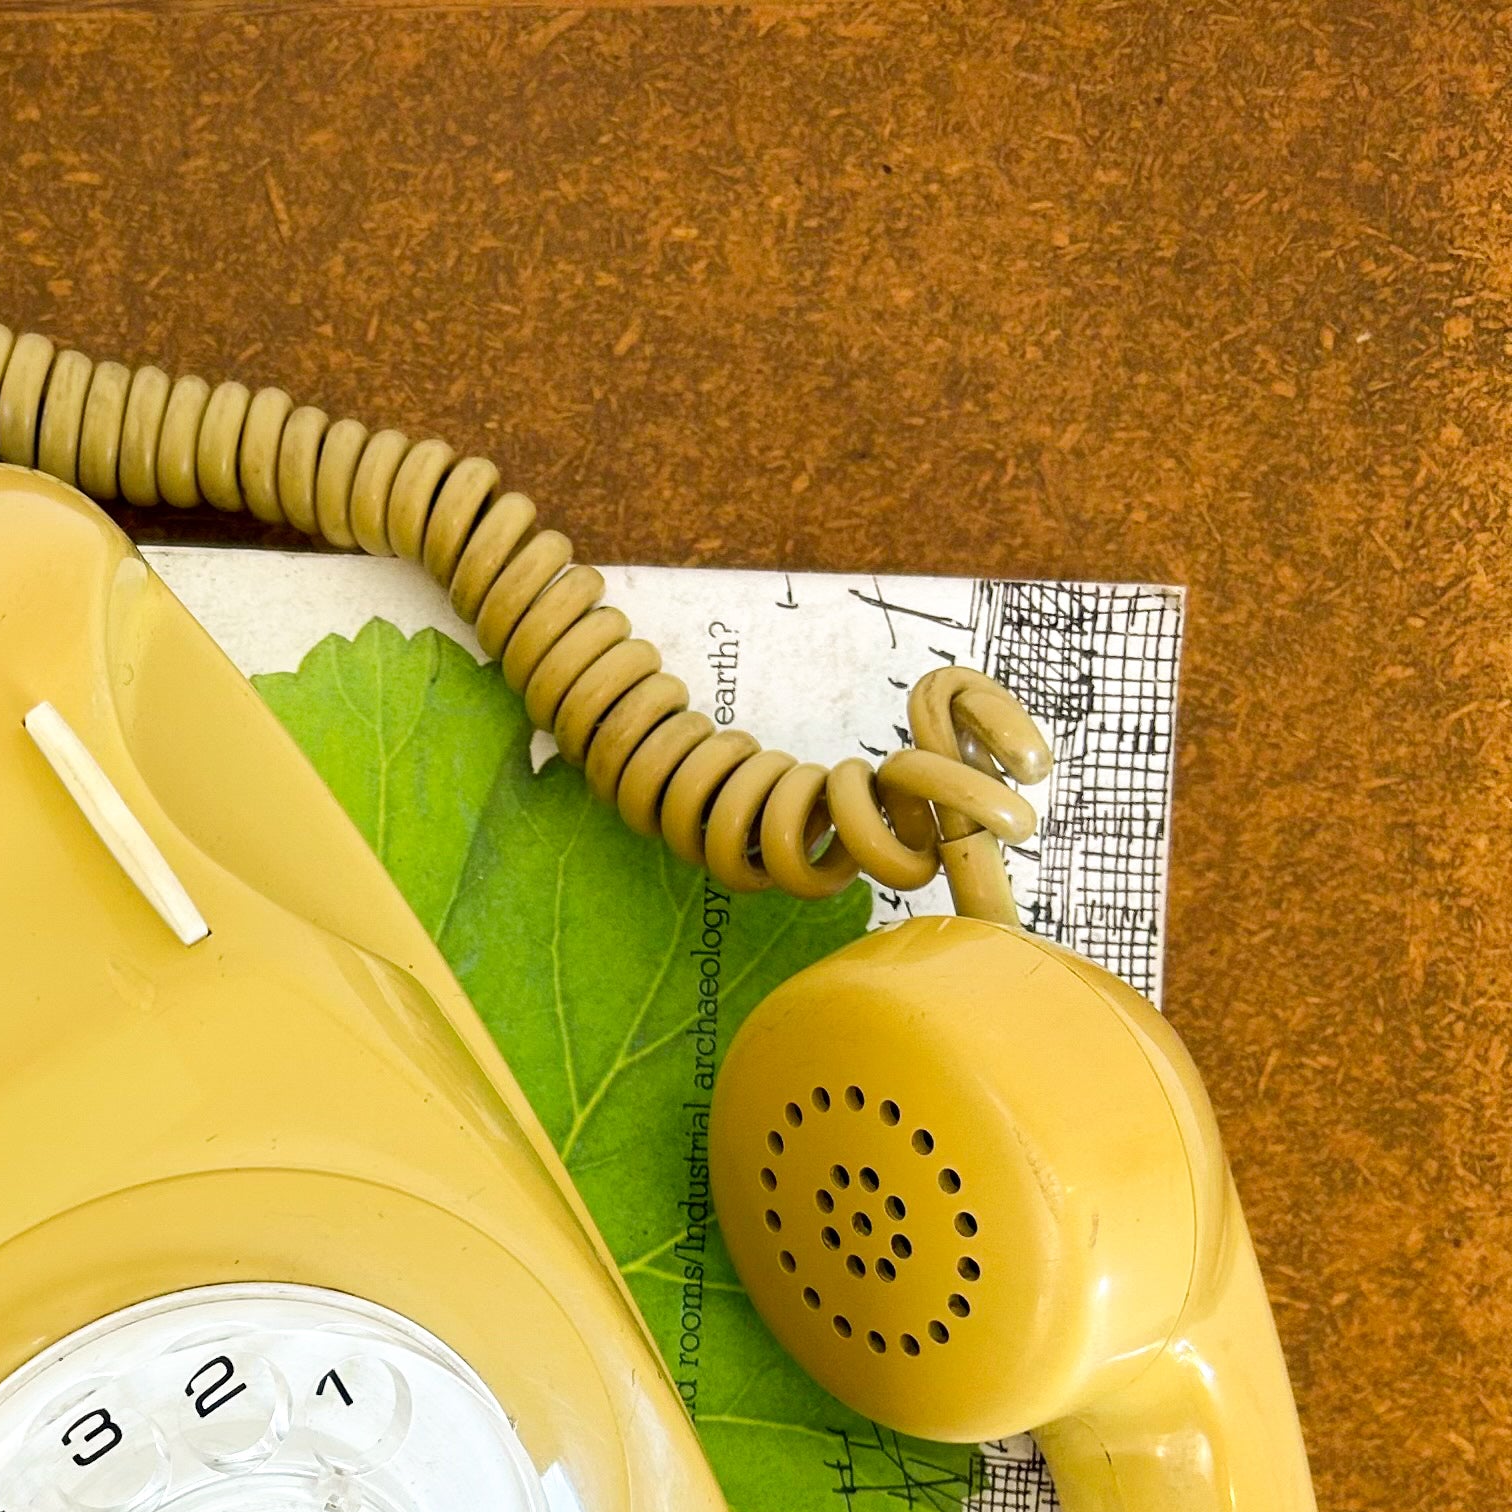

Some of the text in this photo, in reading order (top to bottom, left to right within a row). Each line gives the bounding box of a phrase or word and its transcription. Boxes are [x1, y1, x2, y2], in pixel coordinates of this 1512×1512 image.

[707, 620, 740, 726] earth?
[183, 1354, 248, 1418] 2
[315, 1368, 354, 1407] 1
[60, 1407, 123, 1467] 3
